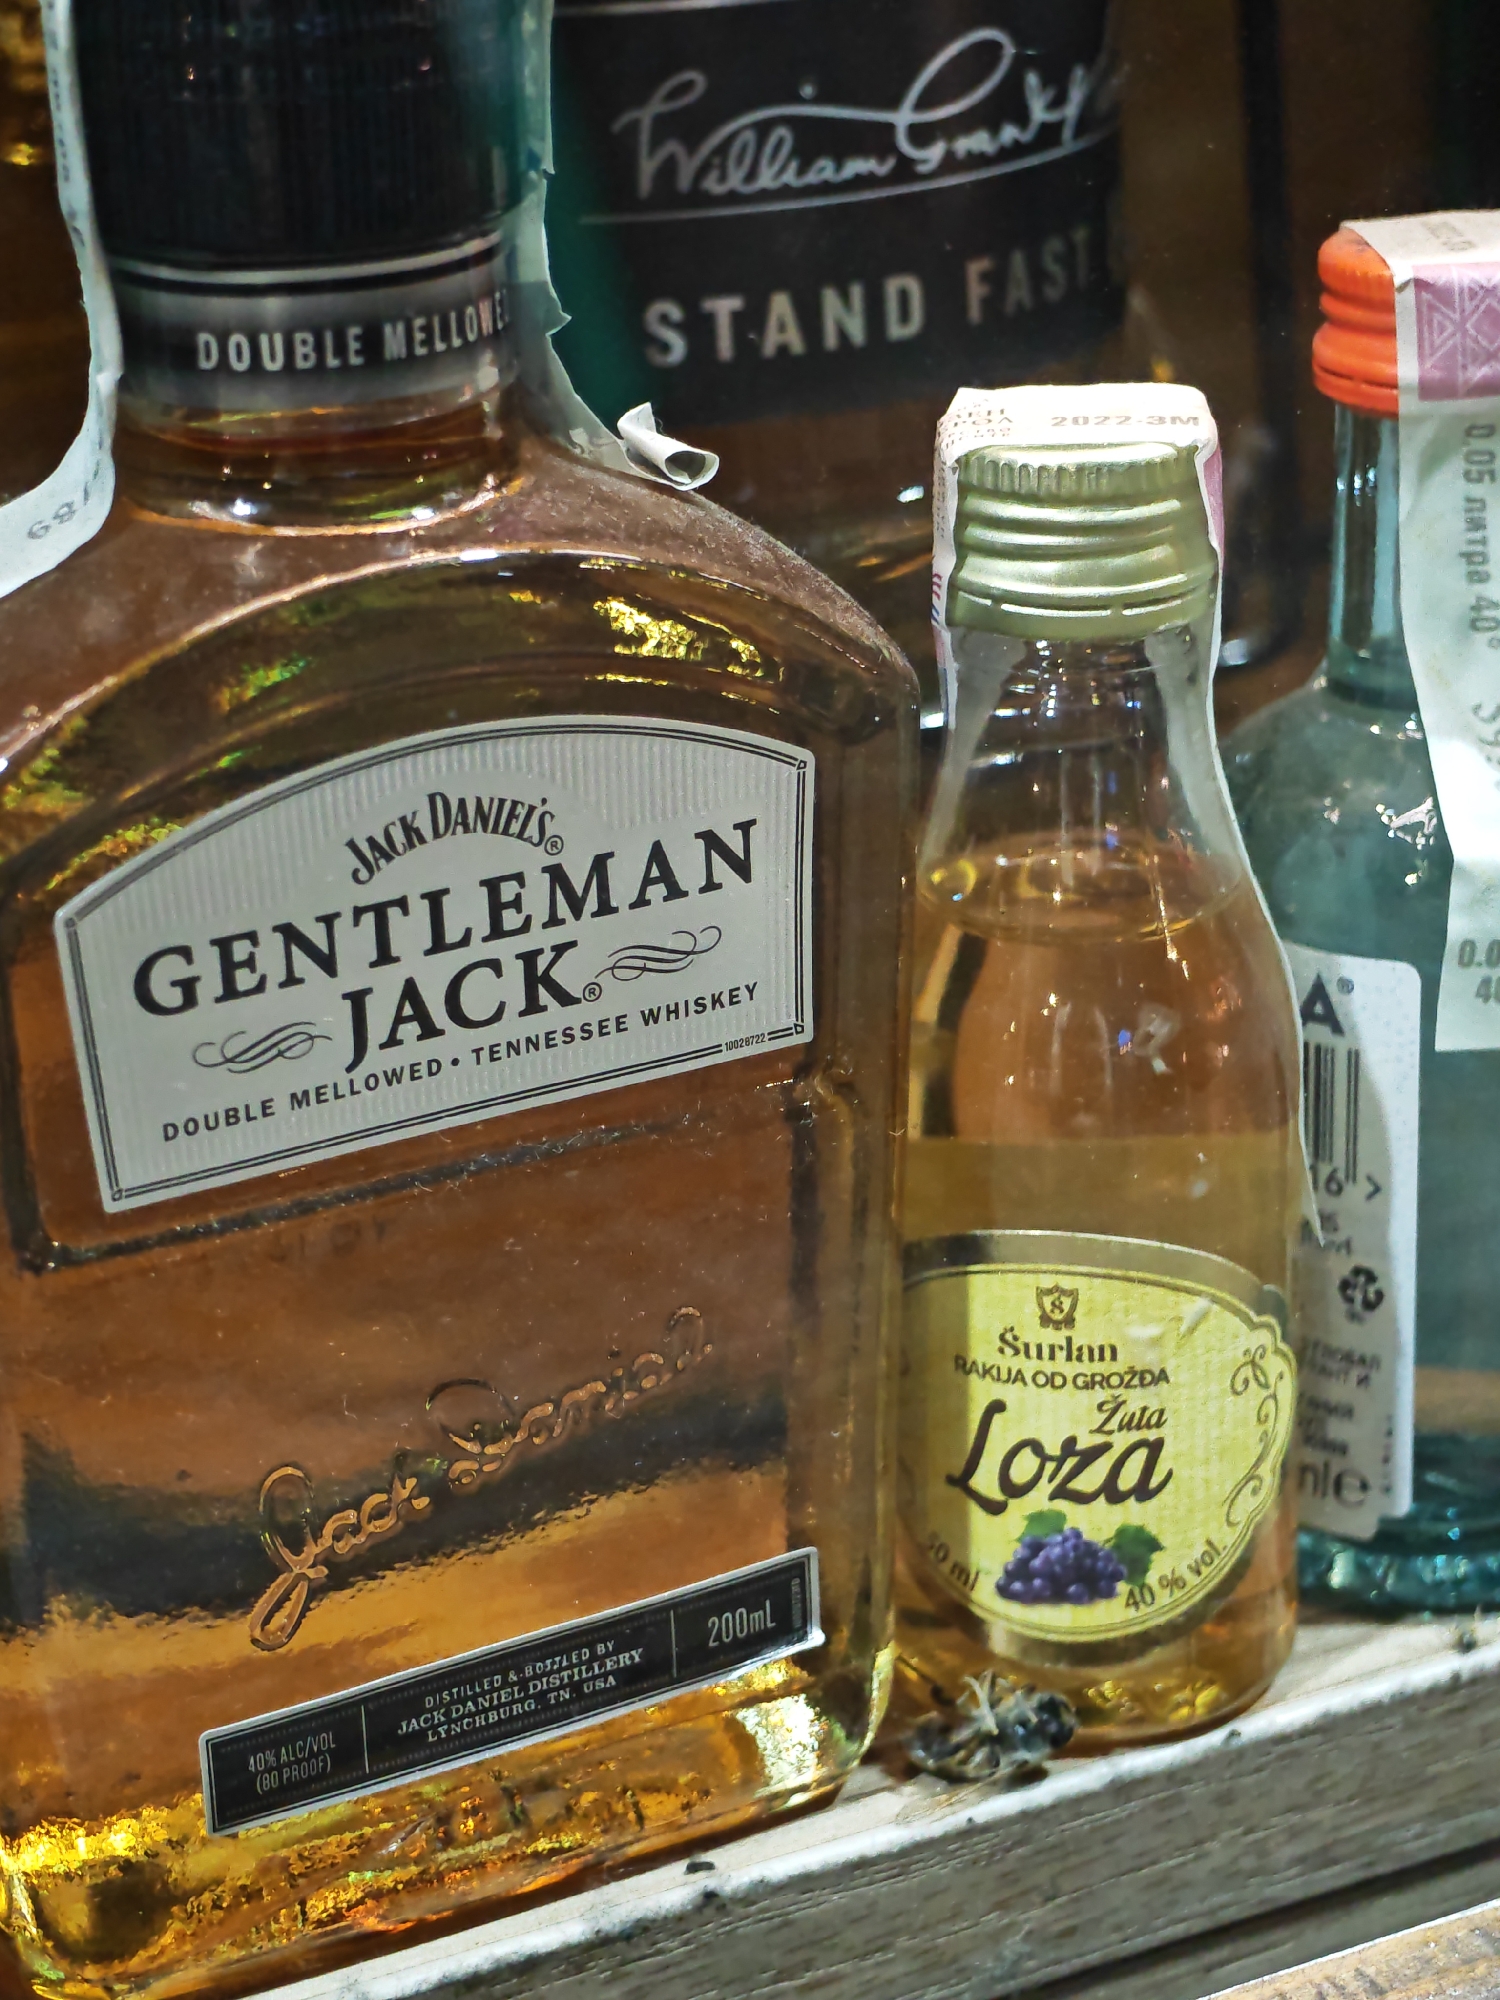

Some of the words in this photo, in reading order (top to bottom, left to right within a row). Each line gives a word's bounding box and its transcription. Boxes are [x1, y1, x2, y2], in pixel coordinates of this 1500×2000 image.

[612, 70, 898, 200] William
[643, 273, 926, 369] STAND
[965, 227, 1091, 326] FAST
[198, 327, 365, 372] DOUBLE
[382, 289, 511, 362] MELLOWE
[1050, 415, 1200, 428] 2022-3M
[345, 809, 428, 885] JACK
[133, 817, 758, 1017] GENTLEMAN
[162, 1098, 276, 1143] DOUBLE
[289, 1056, 443, 1112] MELLOWED
[471, 1014, 629, 1066] TENNESSEE
[641, 981, 759, 1027] WHISKEY
[724, 1032, 767, 1052] 10028722
[997, 1328, 1119, 1364] Šurlan
[953, 1354, 1027, 1387] RAKIJA
[1030, 1369, 1067, 1390] OD
[1071, 1365, 1171, 1391] GROŽĐA
[1089, 1393, 1168, 1436] Žuta
[946, 1398, 1173, 1516] Loza
[950, 1560, 980, 1592] ml
[1124, 1583, 1155, 1612] 40
[1157, 1567, 1187, 1598] %
[707, 1598, 776, 1648] 200mL
[397, 1708, 446, 1736] JACK
[450, 1687, 524, 1720] DANIEL
[527, 1647, 643, 1695] DISTILLERY
[424, 1674, 502, 1709] DISTILLED
[507, 1670, 519, 1684] &
[596, 1639, 615, 1656] BY
[583, 1676, 617, 1694] USA
[248, 1748, 277, 1773] 40%
[280, 1730, 336, 1765] ALC/VOL
[256, 1770, 280, 1795] (80
[282, 1752, 332, 1785] PROOF)
